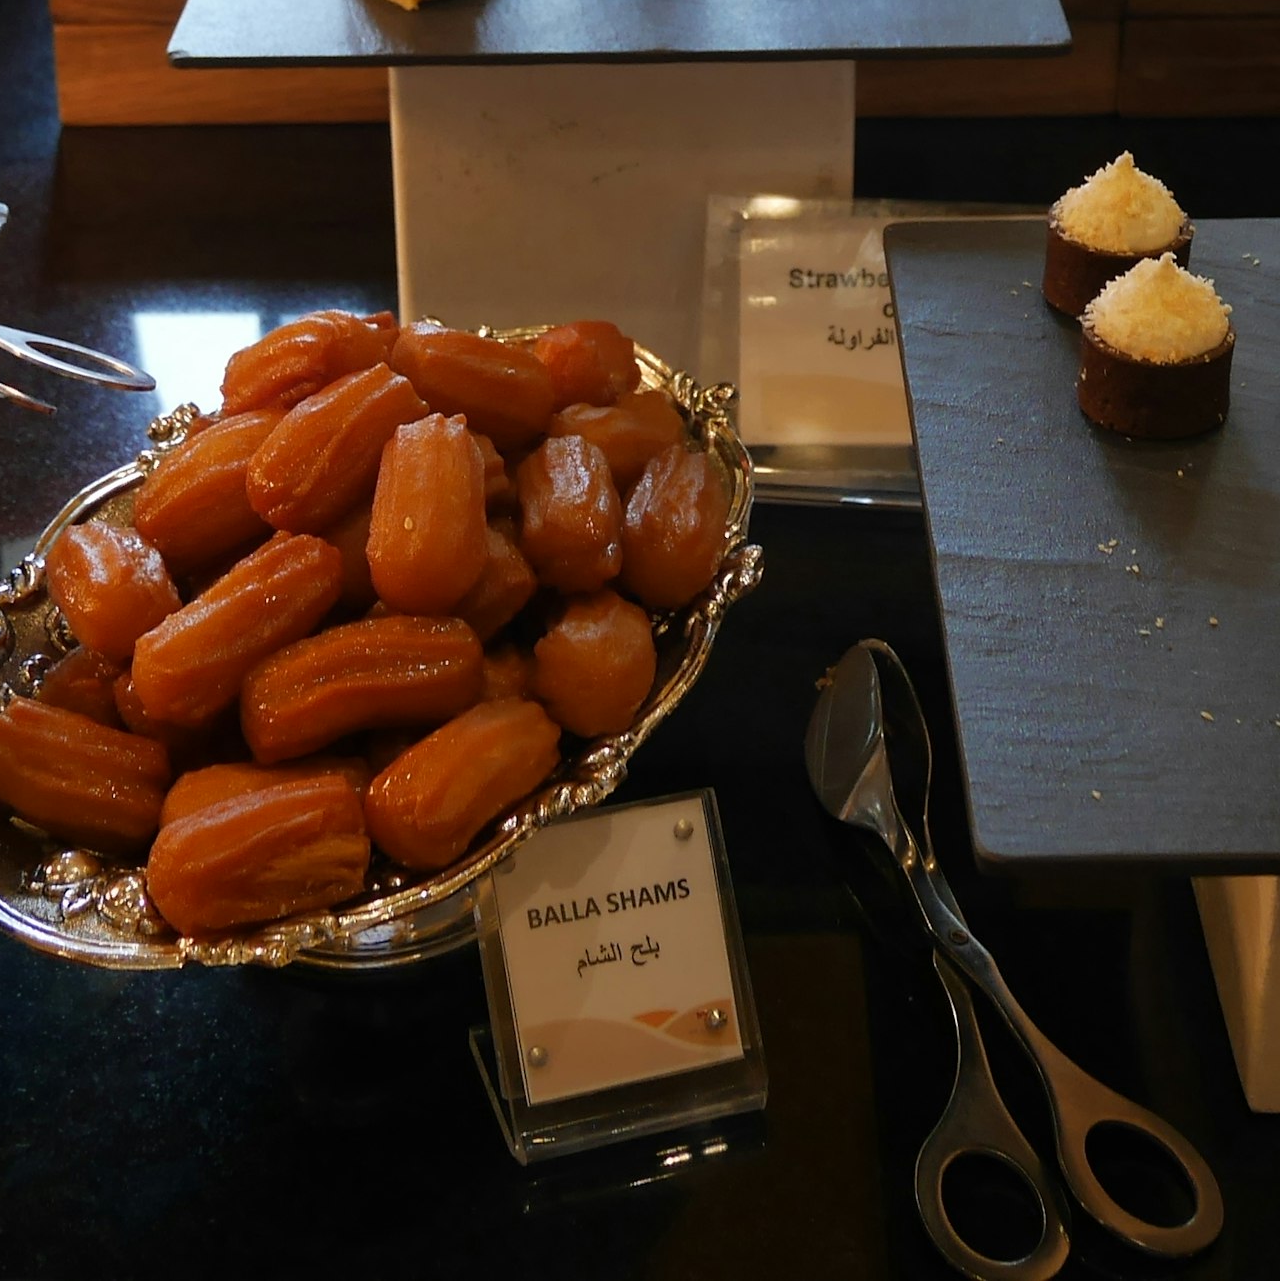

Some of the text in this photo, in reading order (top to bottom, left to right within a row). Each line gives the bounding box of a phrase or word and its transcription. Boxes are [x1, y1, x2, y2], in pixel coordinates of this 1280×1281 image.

[789, 267, 890, 289] Strawbe
[527, 878, 691, 930] BALLA SHAMS
[576, 934, 661, 978] بلح الشام
